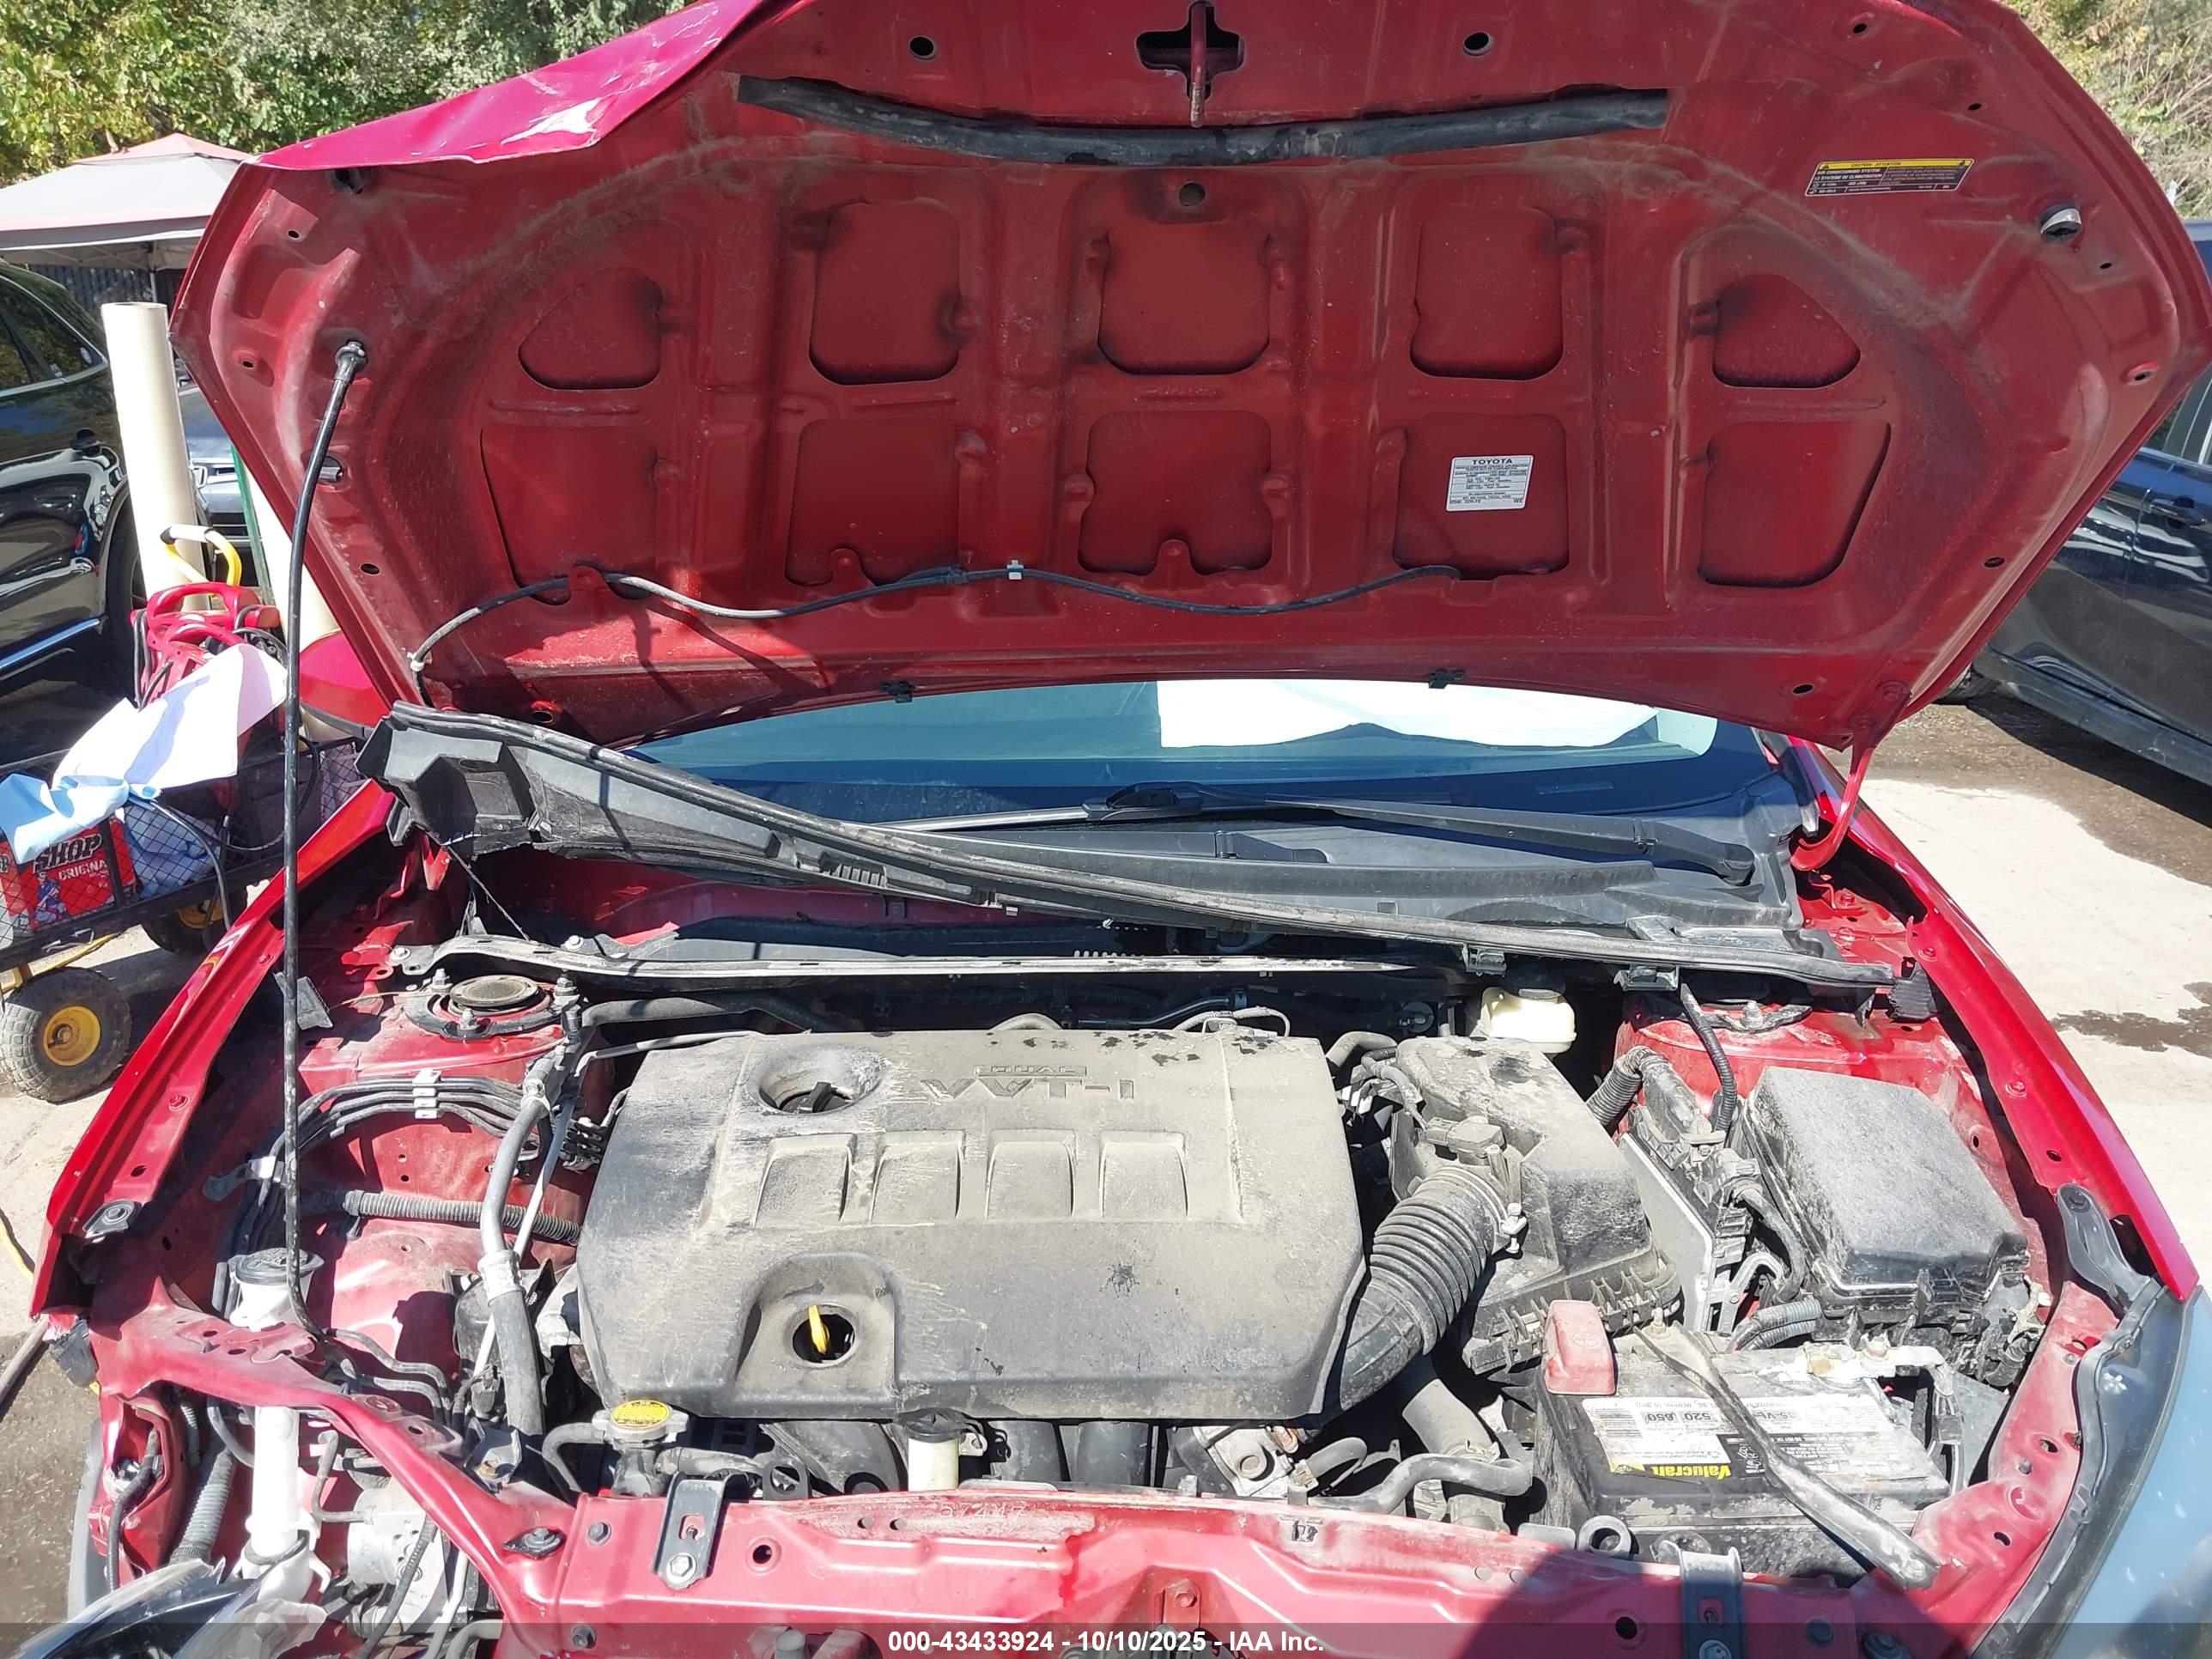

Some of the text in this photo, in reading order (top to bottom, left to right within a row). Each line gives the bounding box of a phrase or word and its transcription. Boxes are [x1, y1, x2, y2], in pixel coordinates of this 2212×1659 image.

[33, 833, 102, 873] SHOP
[58, 860, 108, 880] ORIGINA
[1685, 1413, 1711, 1421] 520
